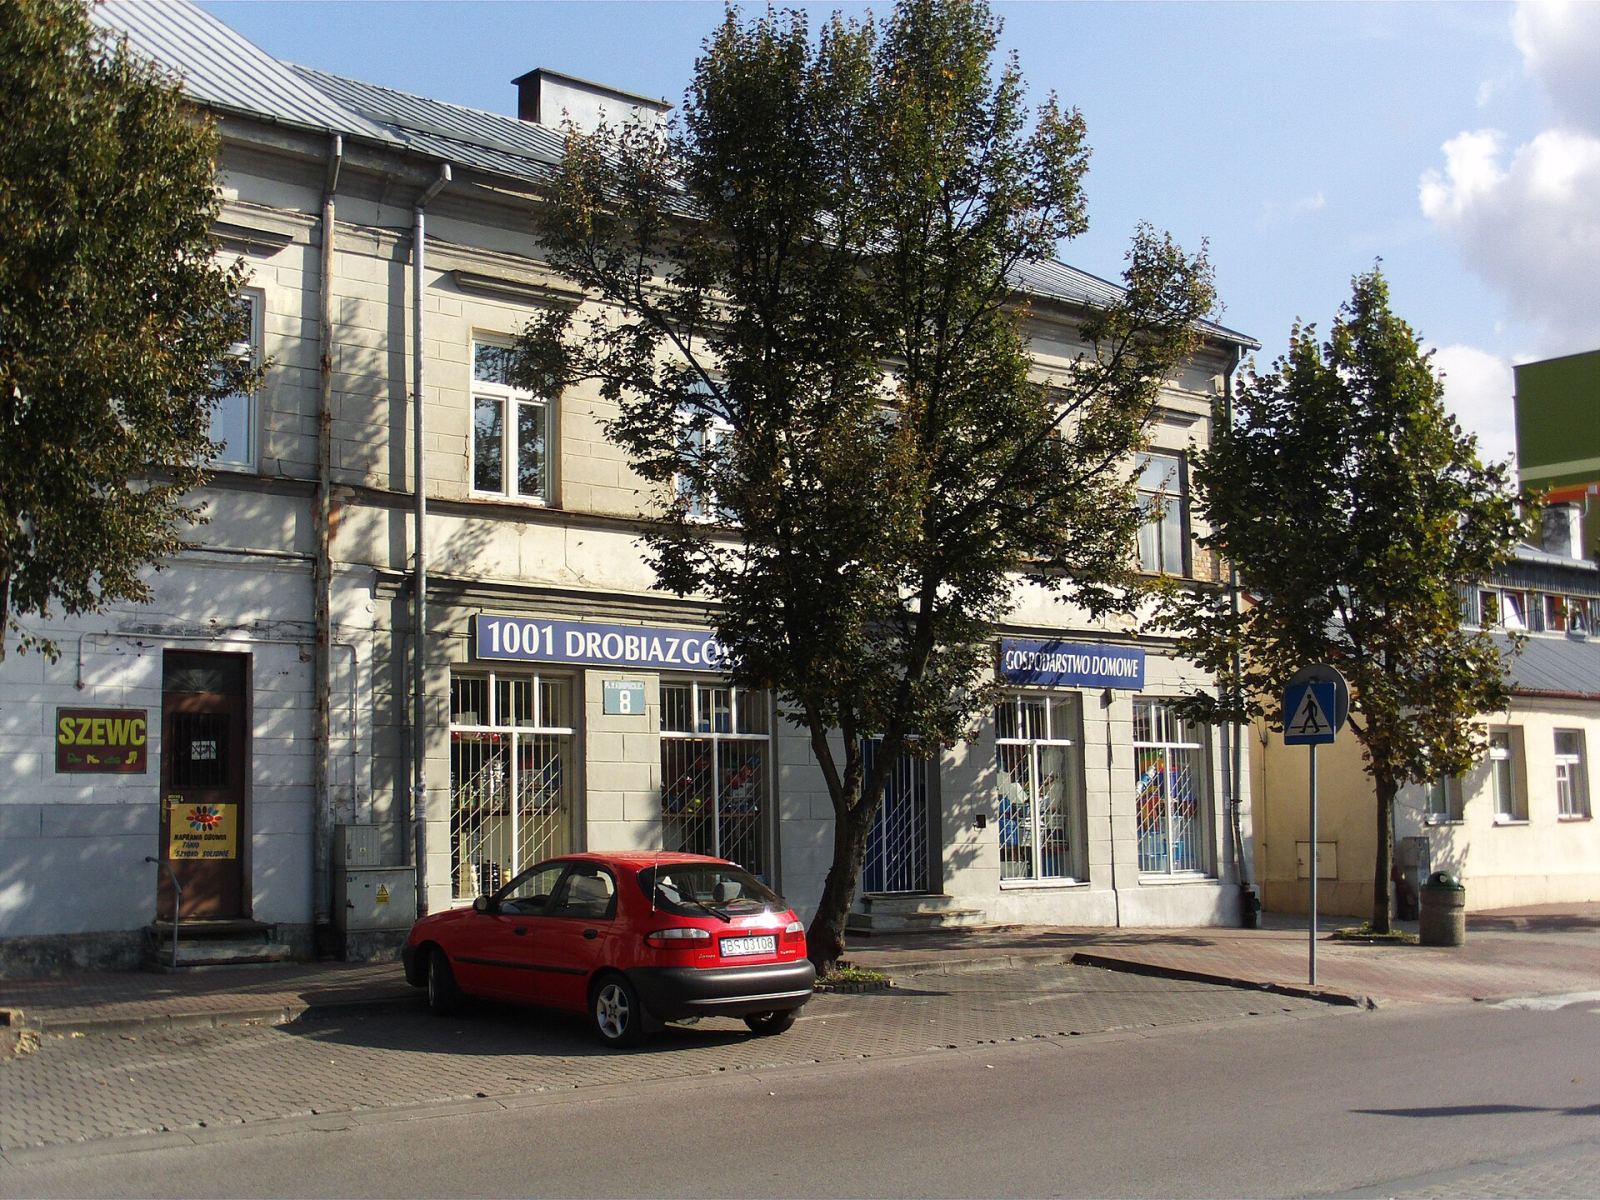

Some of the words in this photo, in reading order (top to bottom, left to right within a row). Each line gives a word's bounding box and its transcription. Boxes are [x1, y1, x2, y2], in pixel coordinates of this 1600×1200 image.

[487, 621, 554, 656] 1001
[565, 630, 744, 667] DROBIAZGÓ
[1005, 650, 1090, 675] GOSPODARSTWO
[1092, 656, 1138, 678] DOMOWE
[620, 690, 631, 714] 8
[58, 717, 146, 746] SZEWC
[726, 939, 741, 952] BS
[743, 937, 774, 951] 03108
